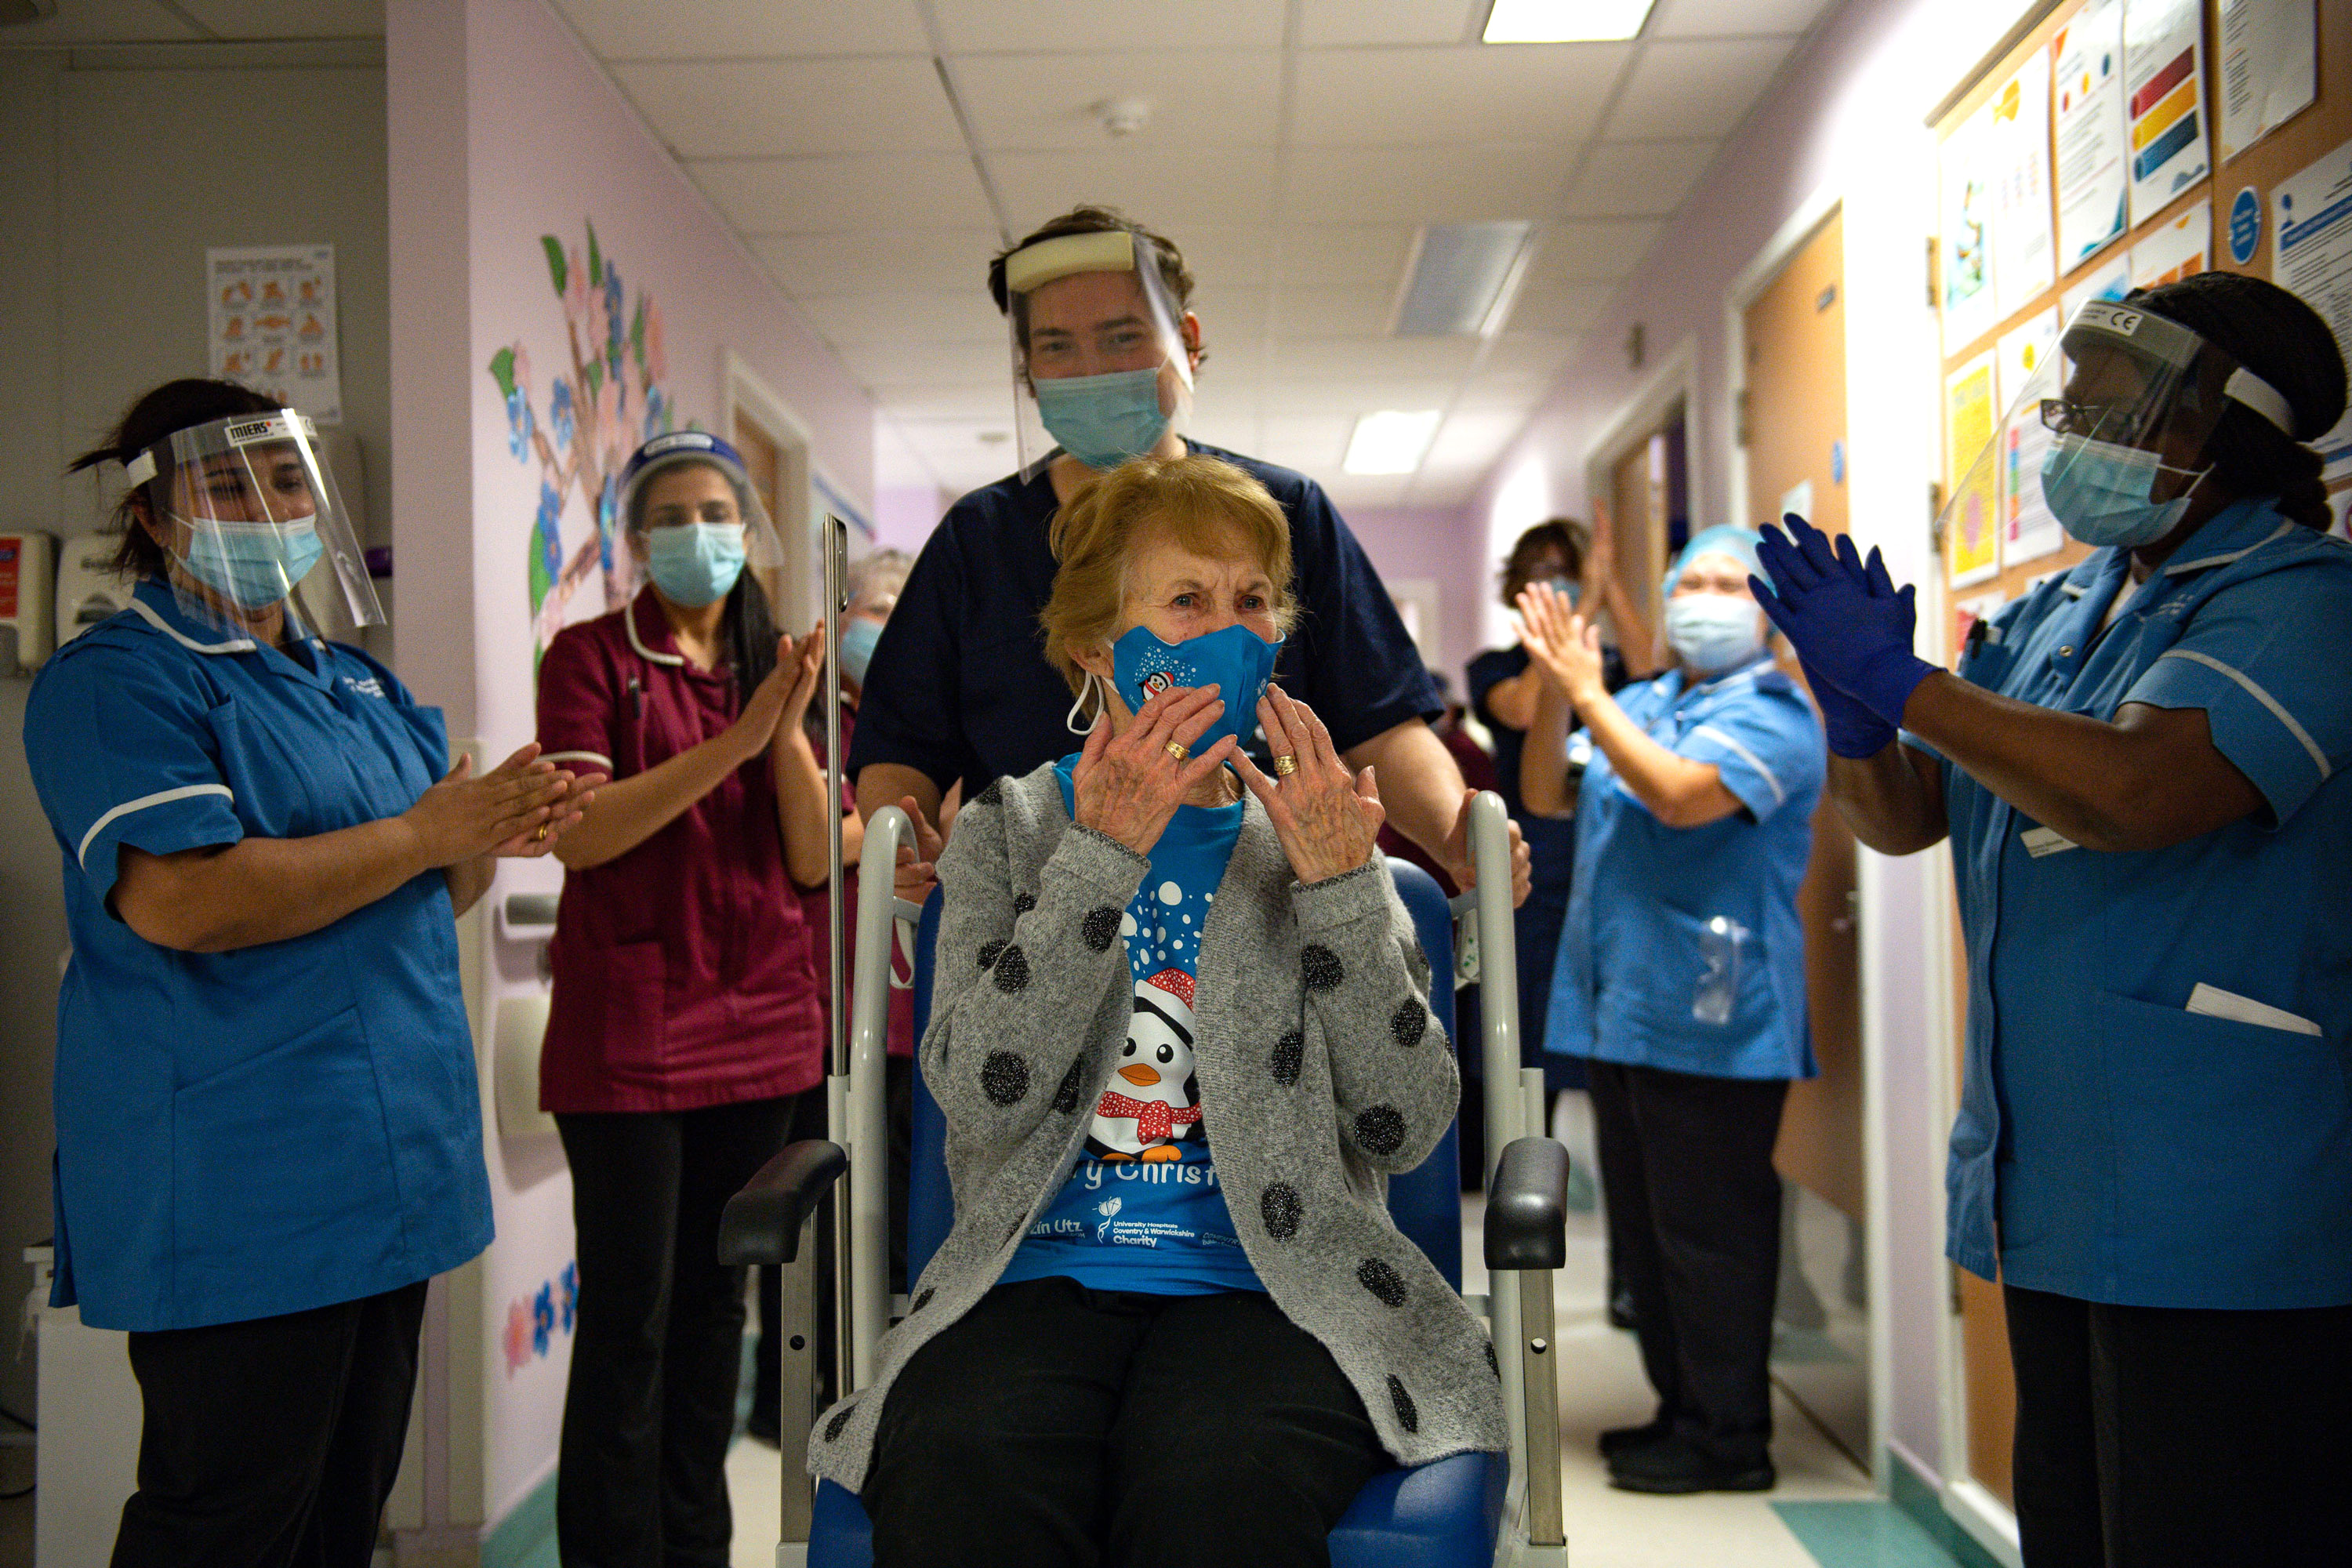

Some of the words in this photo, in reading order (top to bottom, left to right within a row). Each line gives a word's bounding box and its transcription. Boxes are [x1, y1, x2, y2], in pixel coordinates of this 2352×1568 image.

[2111, 311, 2138, 330] CE
[1115, 1160, 1215, 1187] Christ
[1054, 1218, 1083, 1233] Utz
[1150, 1228, 1195, 1238] Warwickshire
[1113, 1235, 1157, 1248] Charity
